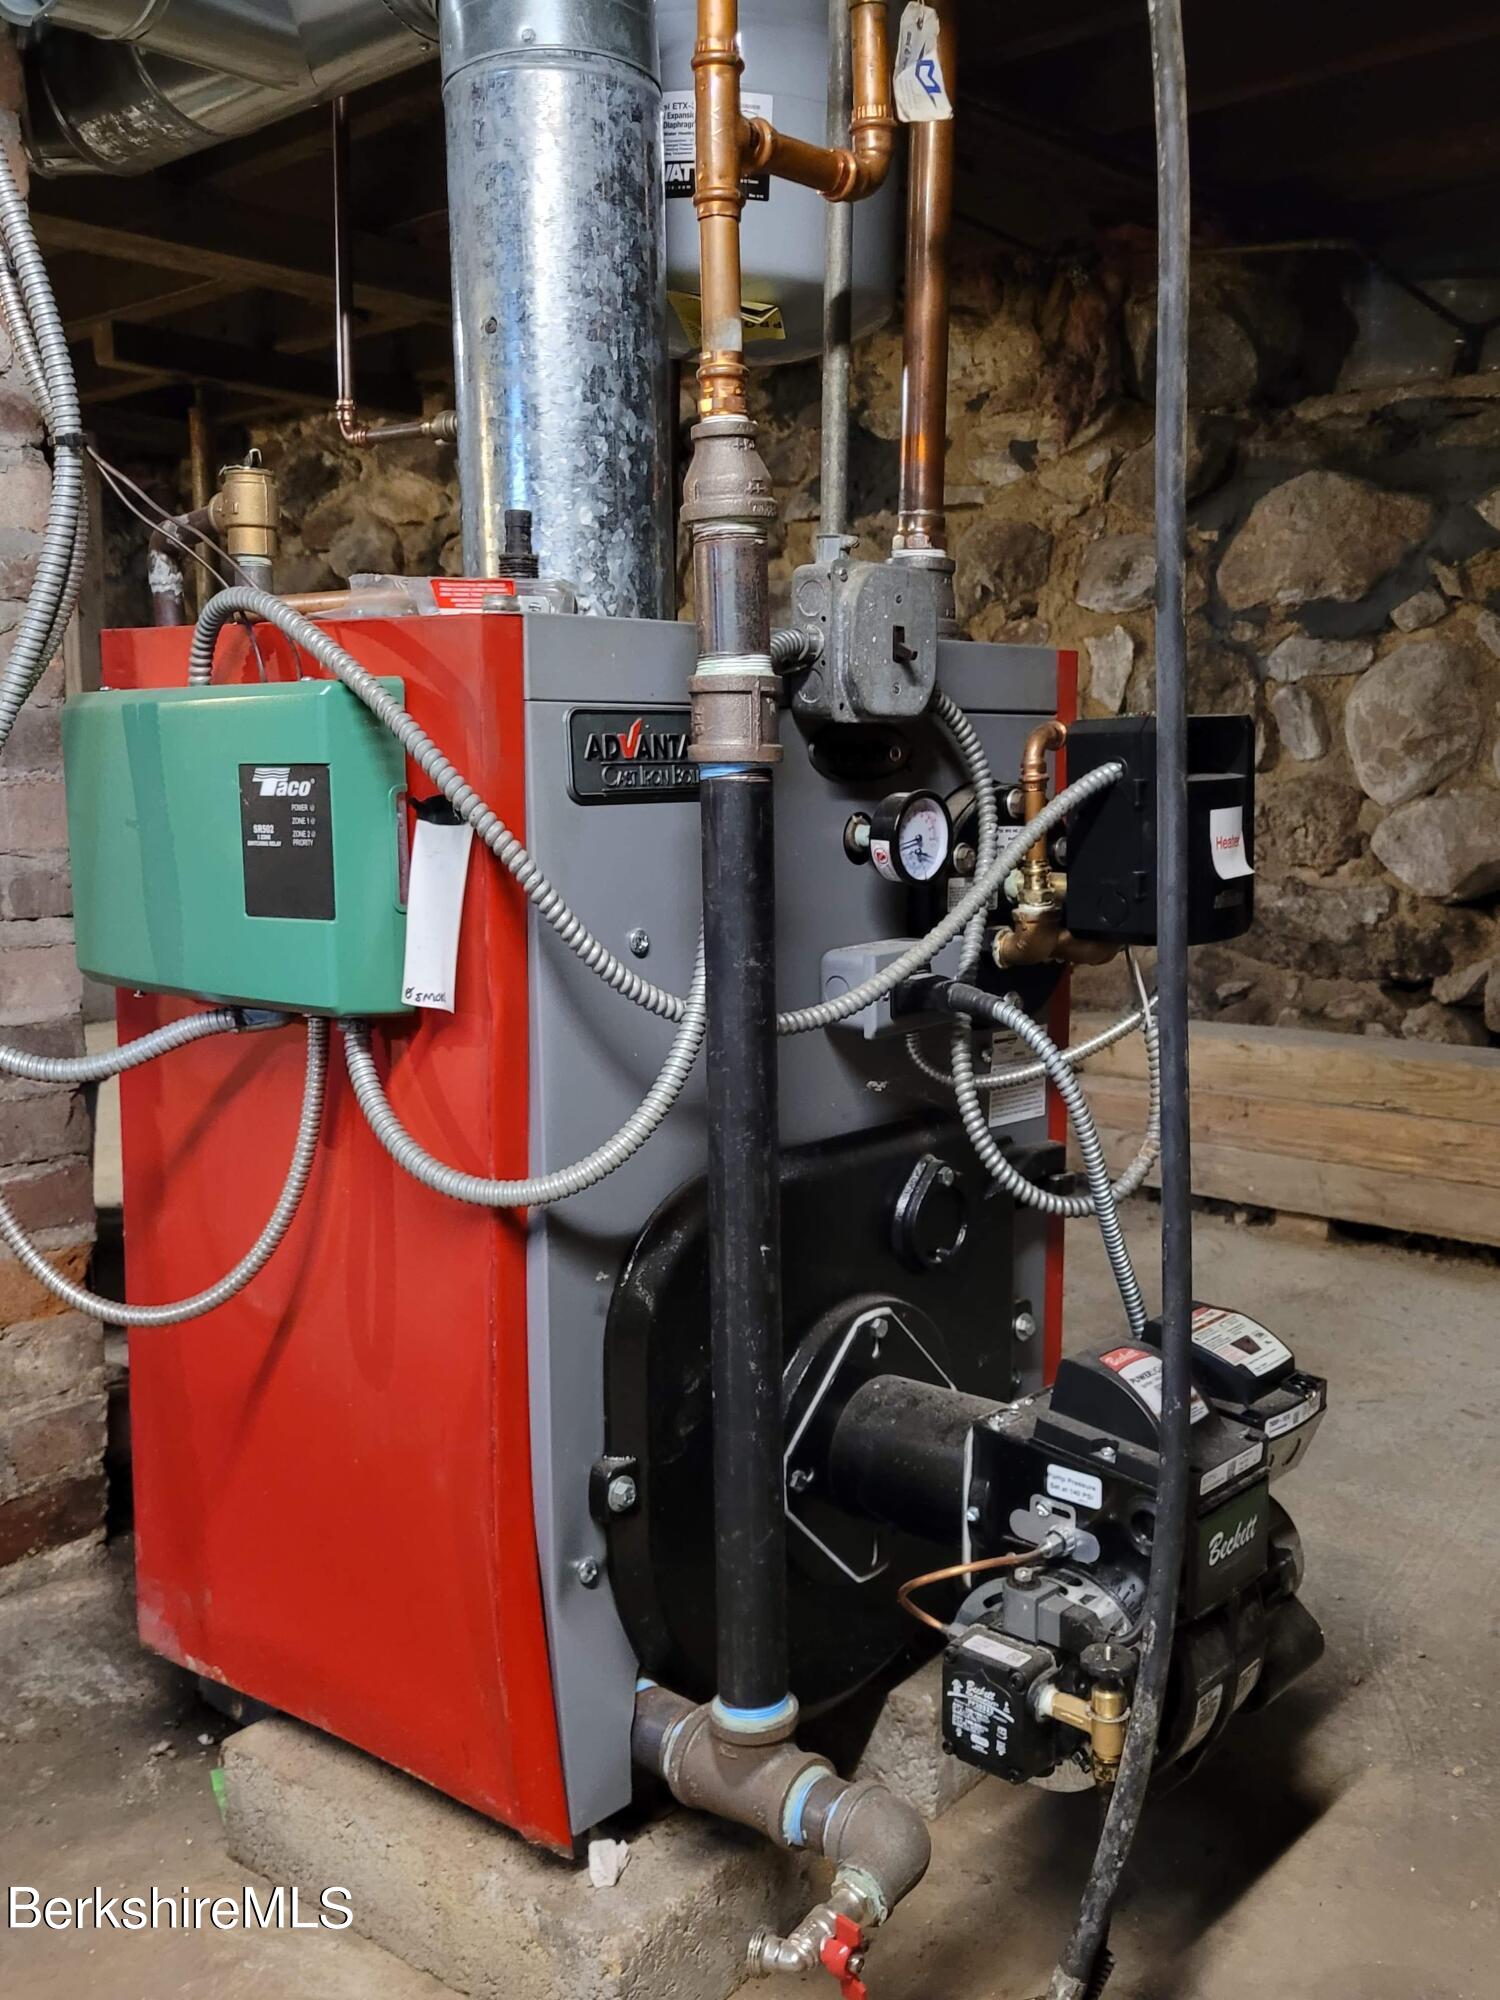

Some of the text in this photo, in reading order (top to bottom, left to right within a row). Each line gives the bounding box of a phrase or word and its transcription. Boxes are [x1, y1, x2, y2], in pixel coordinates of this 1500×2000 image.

[584, 718, 688, 760] ADVANTA
[252, 768, 311, 797] Taco
[671, 764, 699, 785] Boi
[291, 803, 308, 812] POWER
[292, 817, 306, 825] ZONE
[292, 830, 306, 838] ZONE
[1216, 835, 1240, 850] Heater
[1209, 1515, 1257, 1566] Beckett
